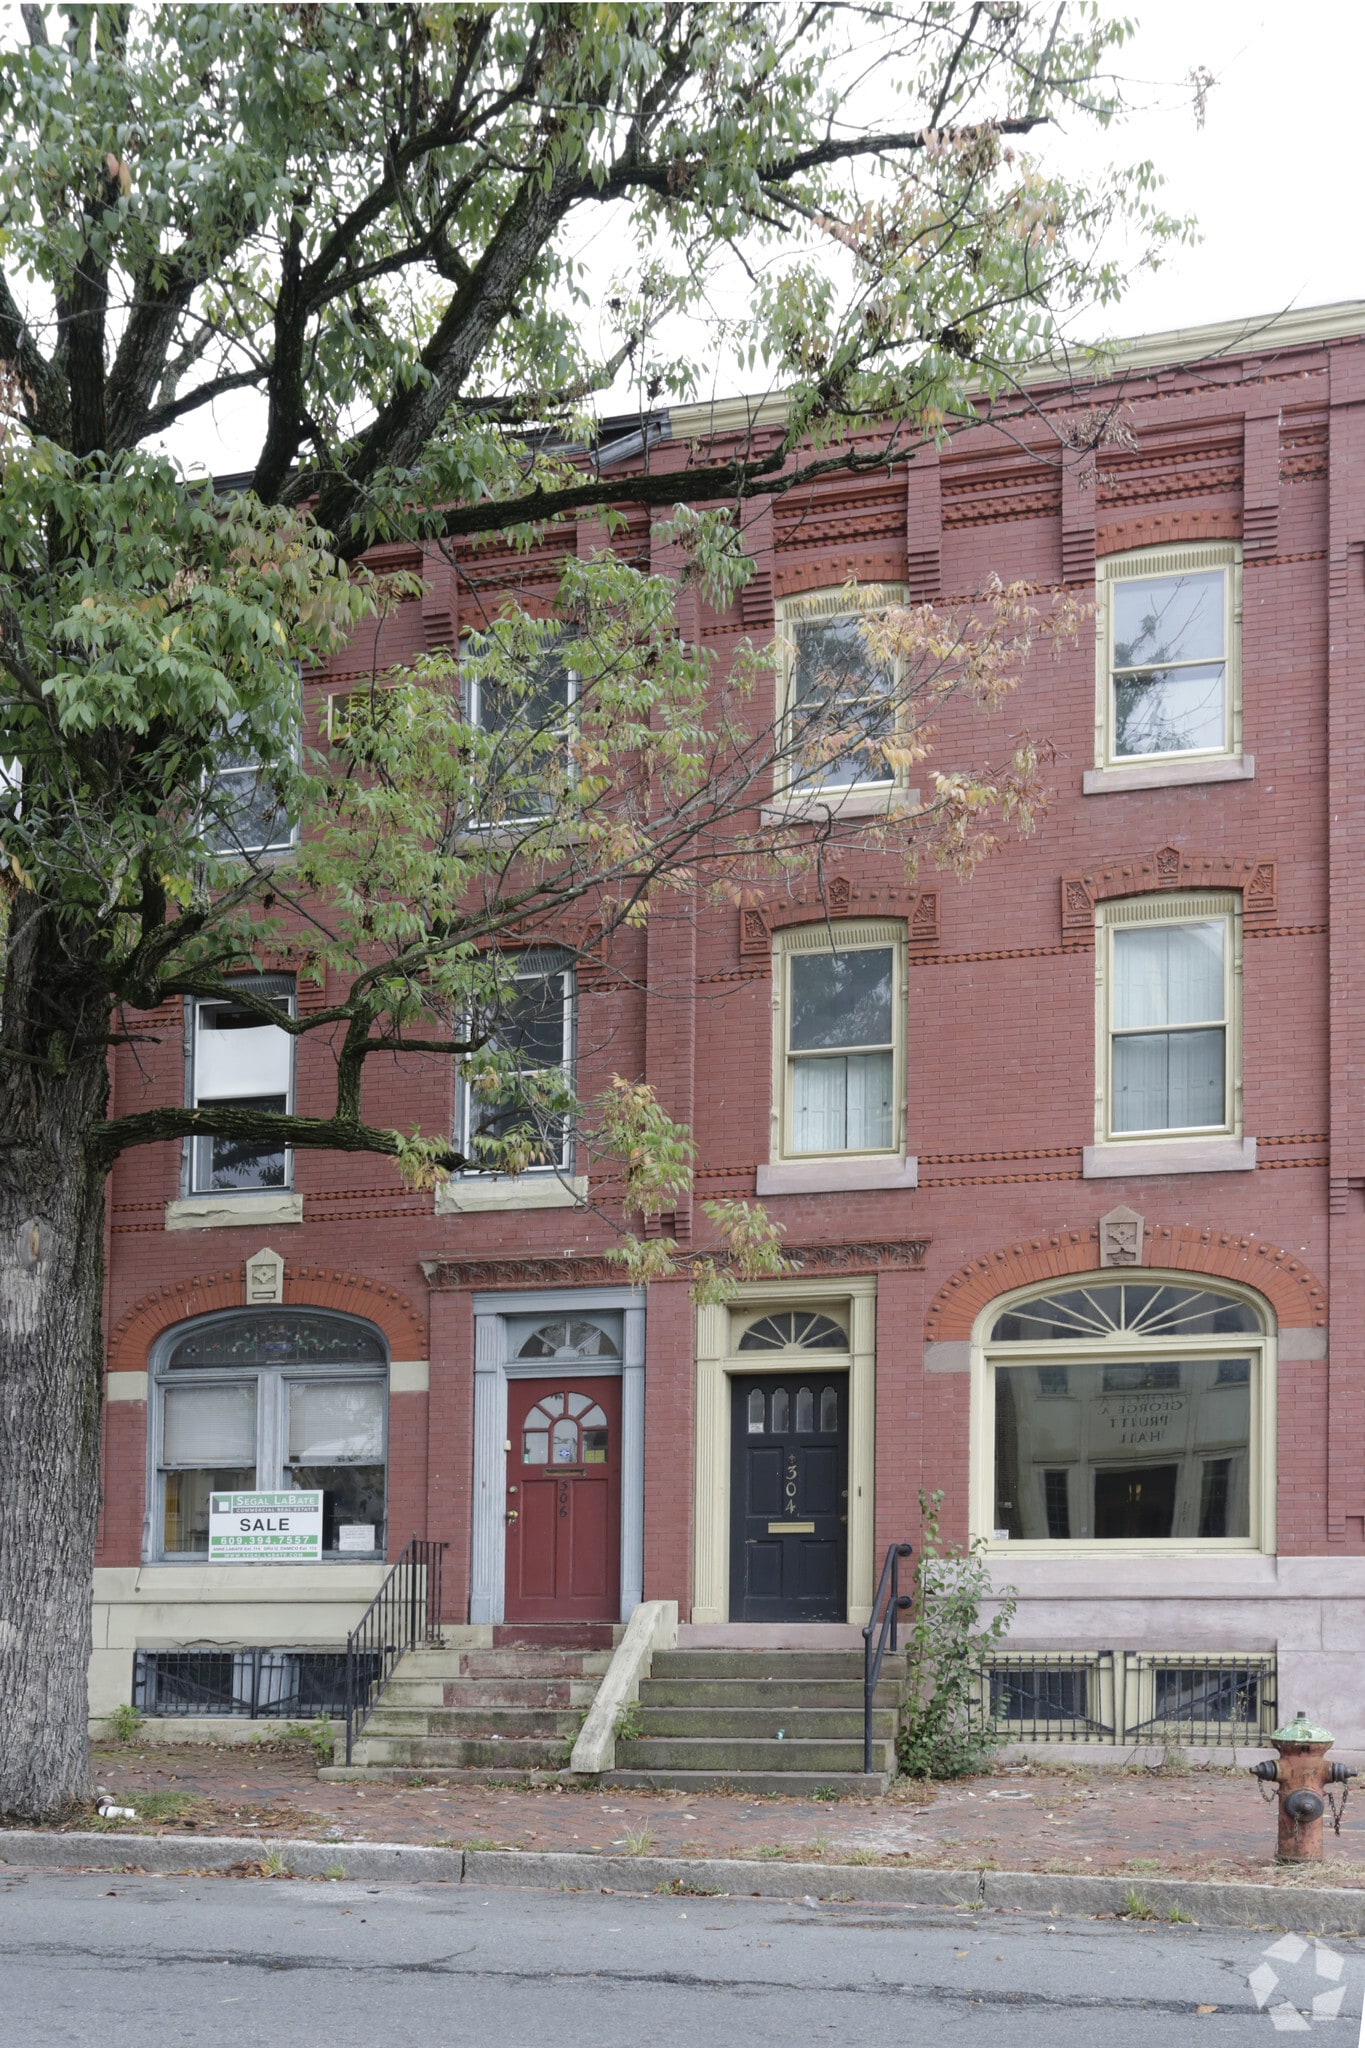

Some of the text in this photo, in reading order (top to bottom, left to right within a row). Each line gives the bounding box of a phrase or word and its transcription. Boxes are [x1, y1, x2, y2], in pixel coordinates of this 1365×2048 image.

[785, 1464, 798, 1514] 304
[237, 1496, 269, 1505] SEGAL
[559, 1480, 568, 1518] 306
[240, 1518, 290, 1531] SALE
[221, 1536, 310, 1545] 609.394.7557
